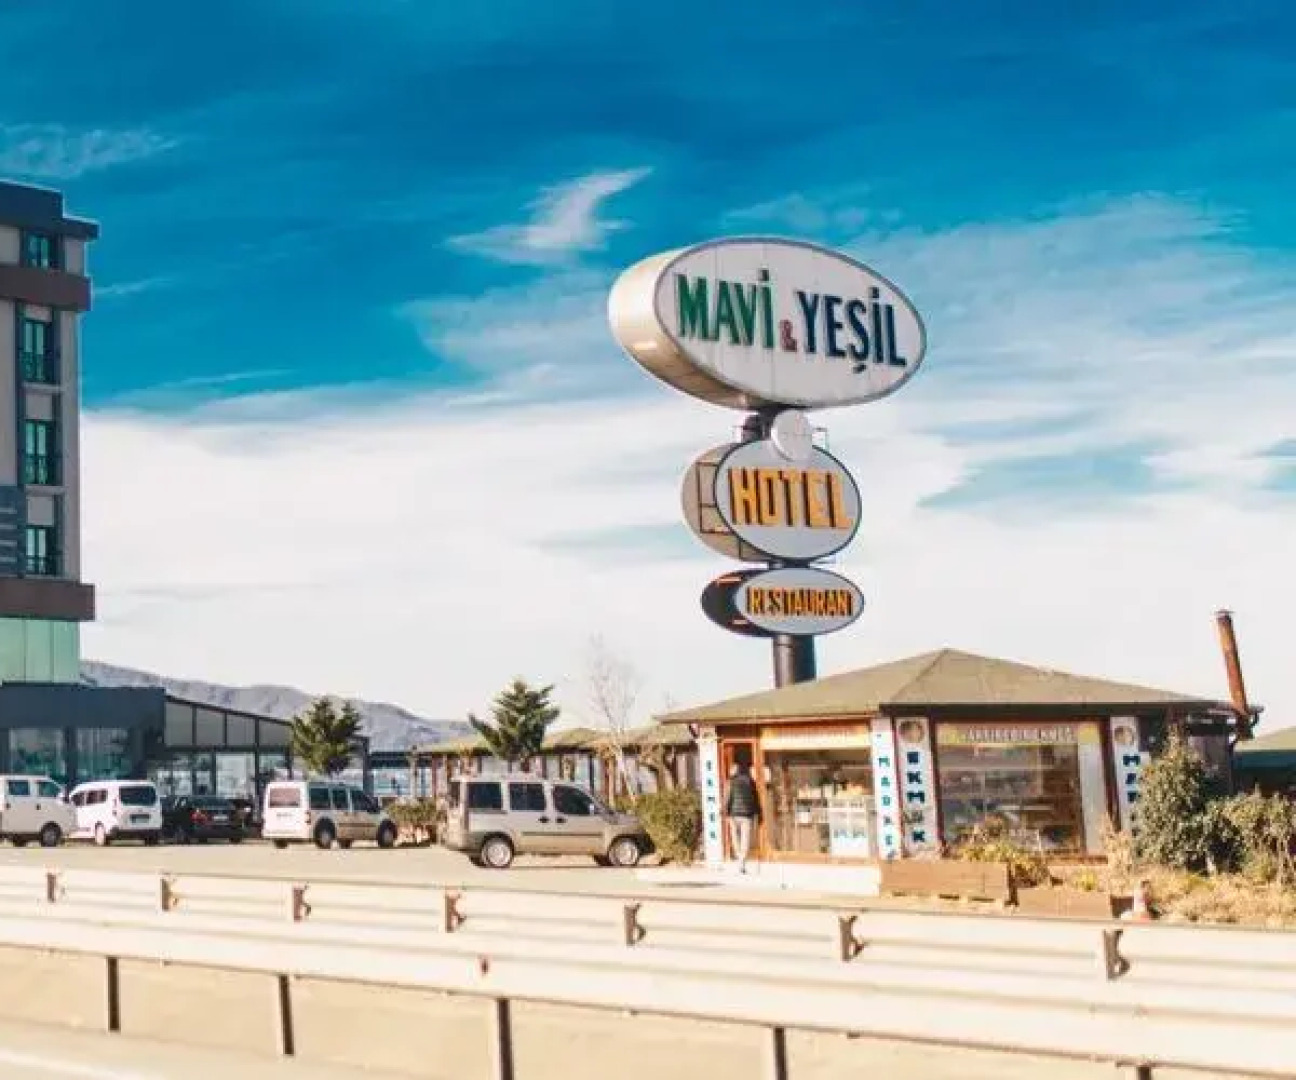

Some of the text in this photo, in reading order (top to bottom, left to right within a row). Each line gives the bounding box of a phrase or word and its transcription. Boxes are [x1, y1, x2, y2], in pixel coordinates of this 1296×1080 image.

[675, 268, 908, 374] MAVİ & YEŞİL
[727, 466, 854, 530] HOTEL
